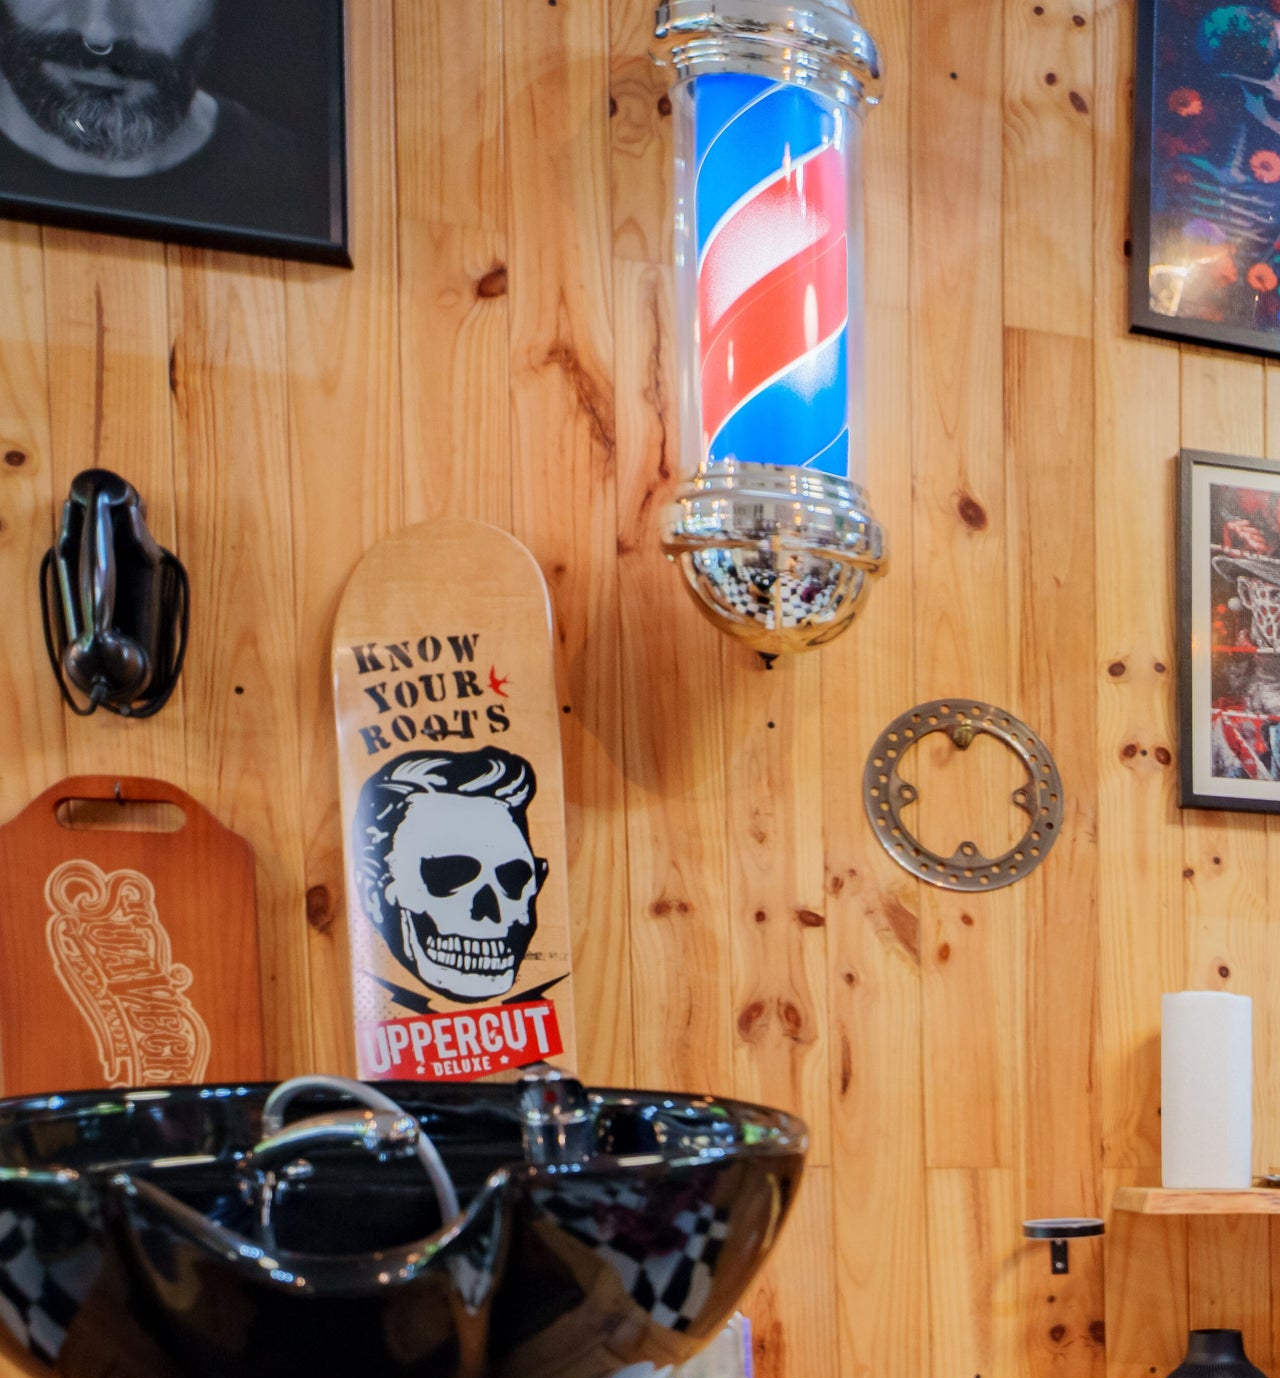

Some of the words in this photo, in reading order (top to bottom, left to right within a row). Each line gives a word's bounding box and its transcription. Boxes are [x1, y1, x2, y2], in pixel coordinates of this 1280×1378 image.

[351, 633, 481, 676] KNOW
[364, 670, 484, 714] YOUR
[359, 703, 511, 755] ROOTS
[364, 1005, 551, 1074] UPPERCUT
[433, 1055, 492, 1077] DELUXE
